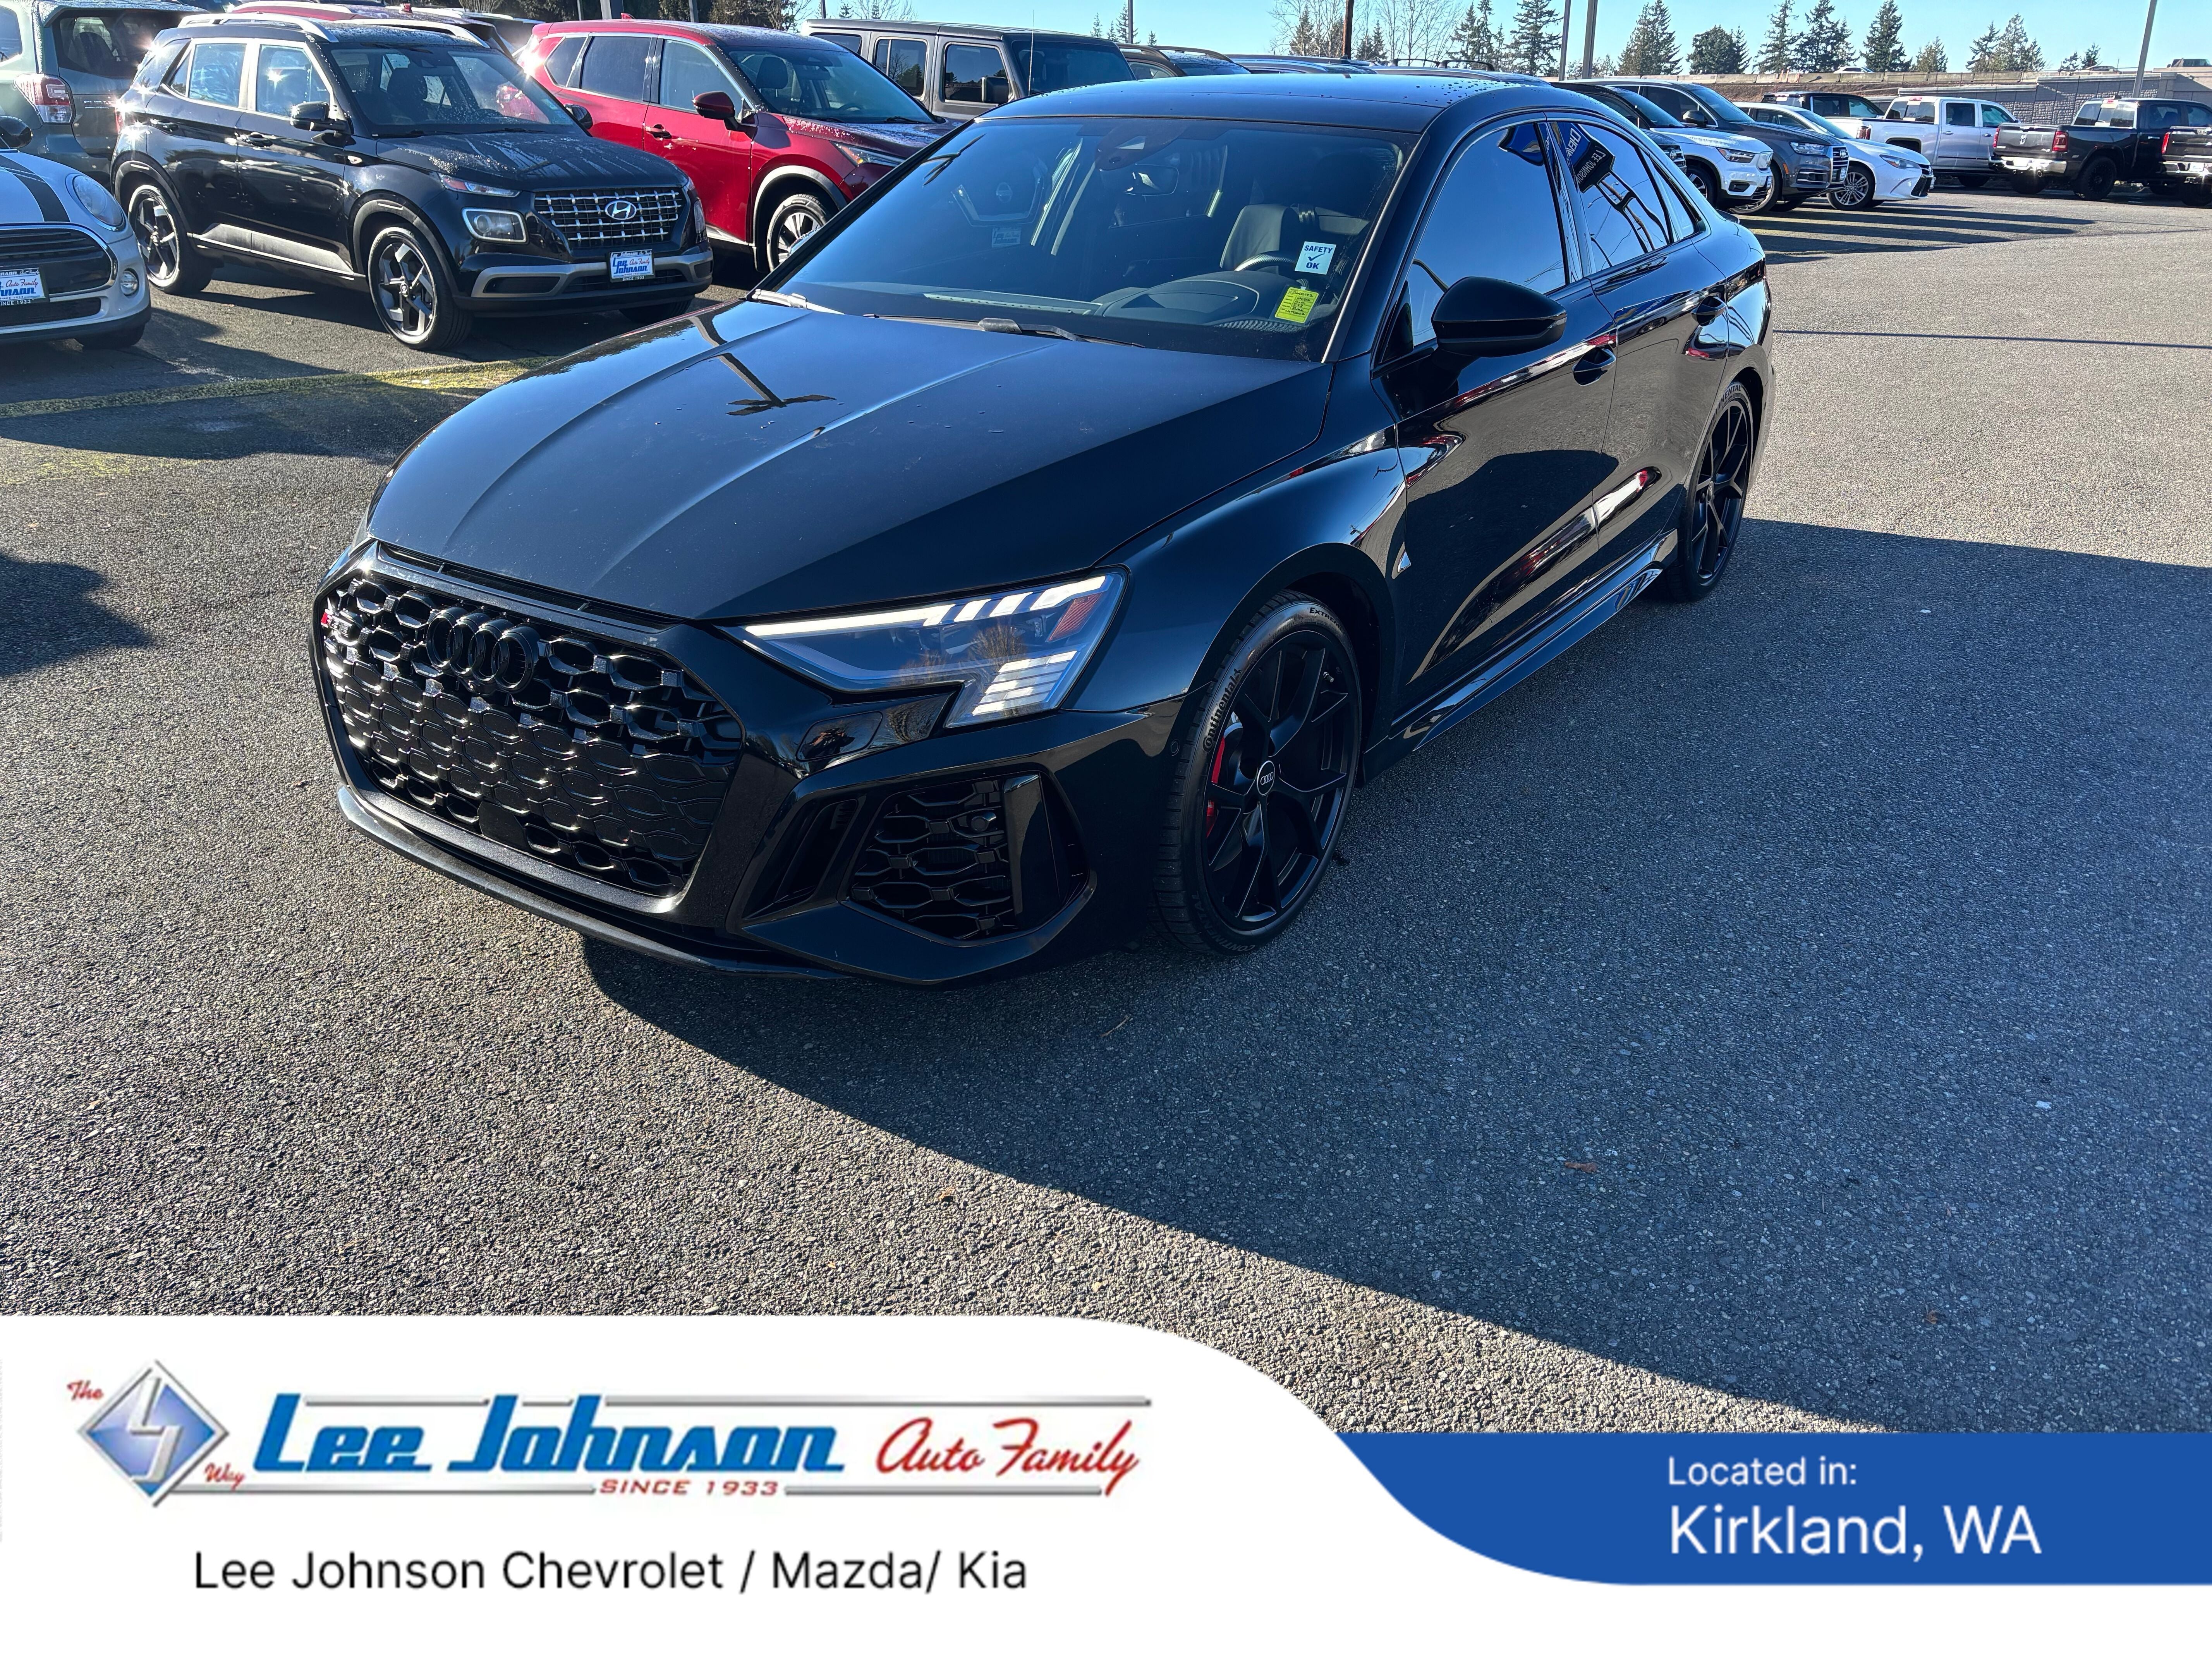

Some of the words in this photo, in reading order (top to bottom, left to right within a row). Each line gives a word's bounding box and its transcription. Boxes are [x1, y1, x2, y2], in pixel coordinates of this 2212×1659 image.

[1304, 245, 1333, 254] SAFETY
[613, 258, 628, 267] Lee
[614, 264, 648, 274] Johnson
[19, 278, 38, 288] Family
[1202, 675, 1240, 752] Continental
